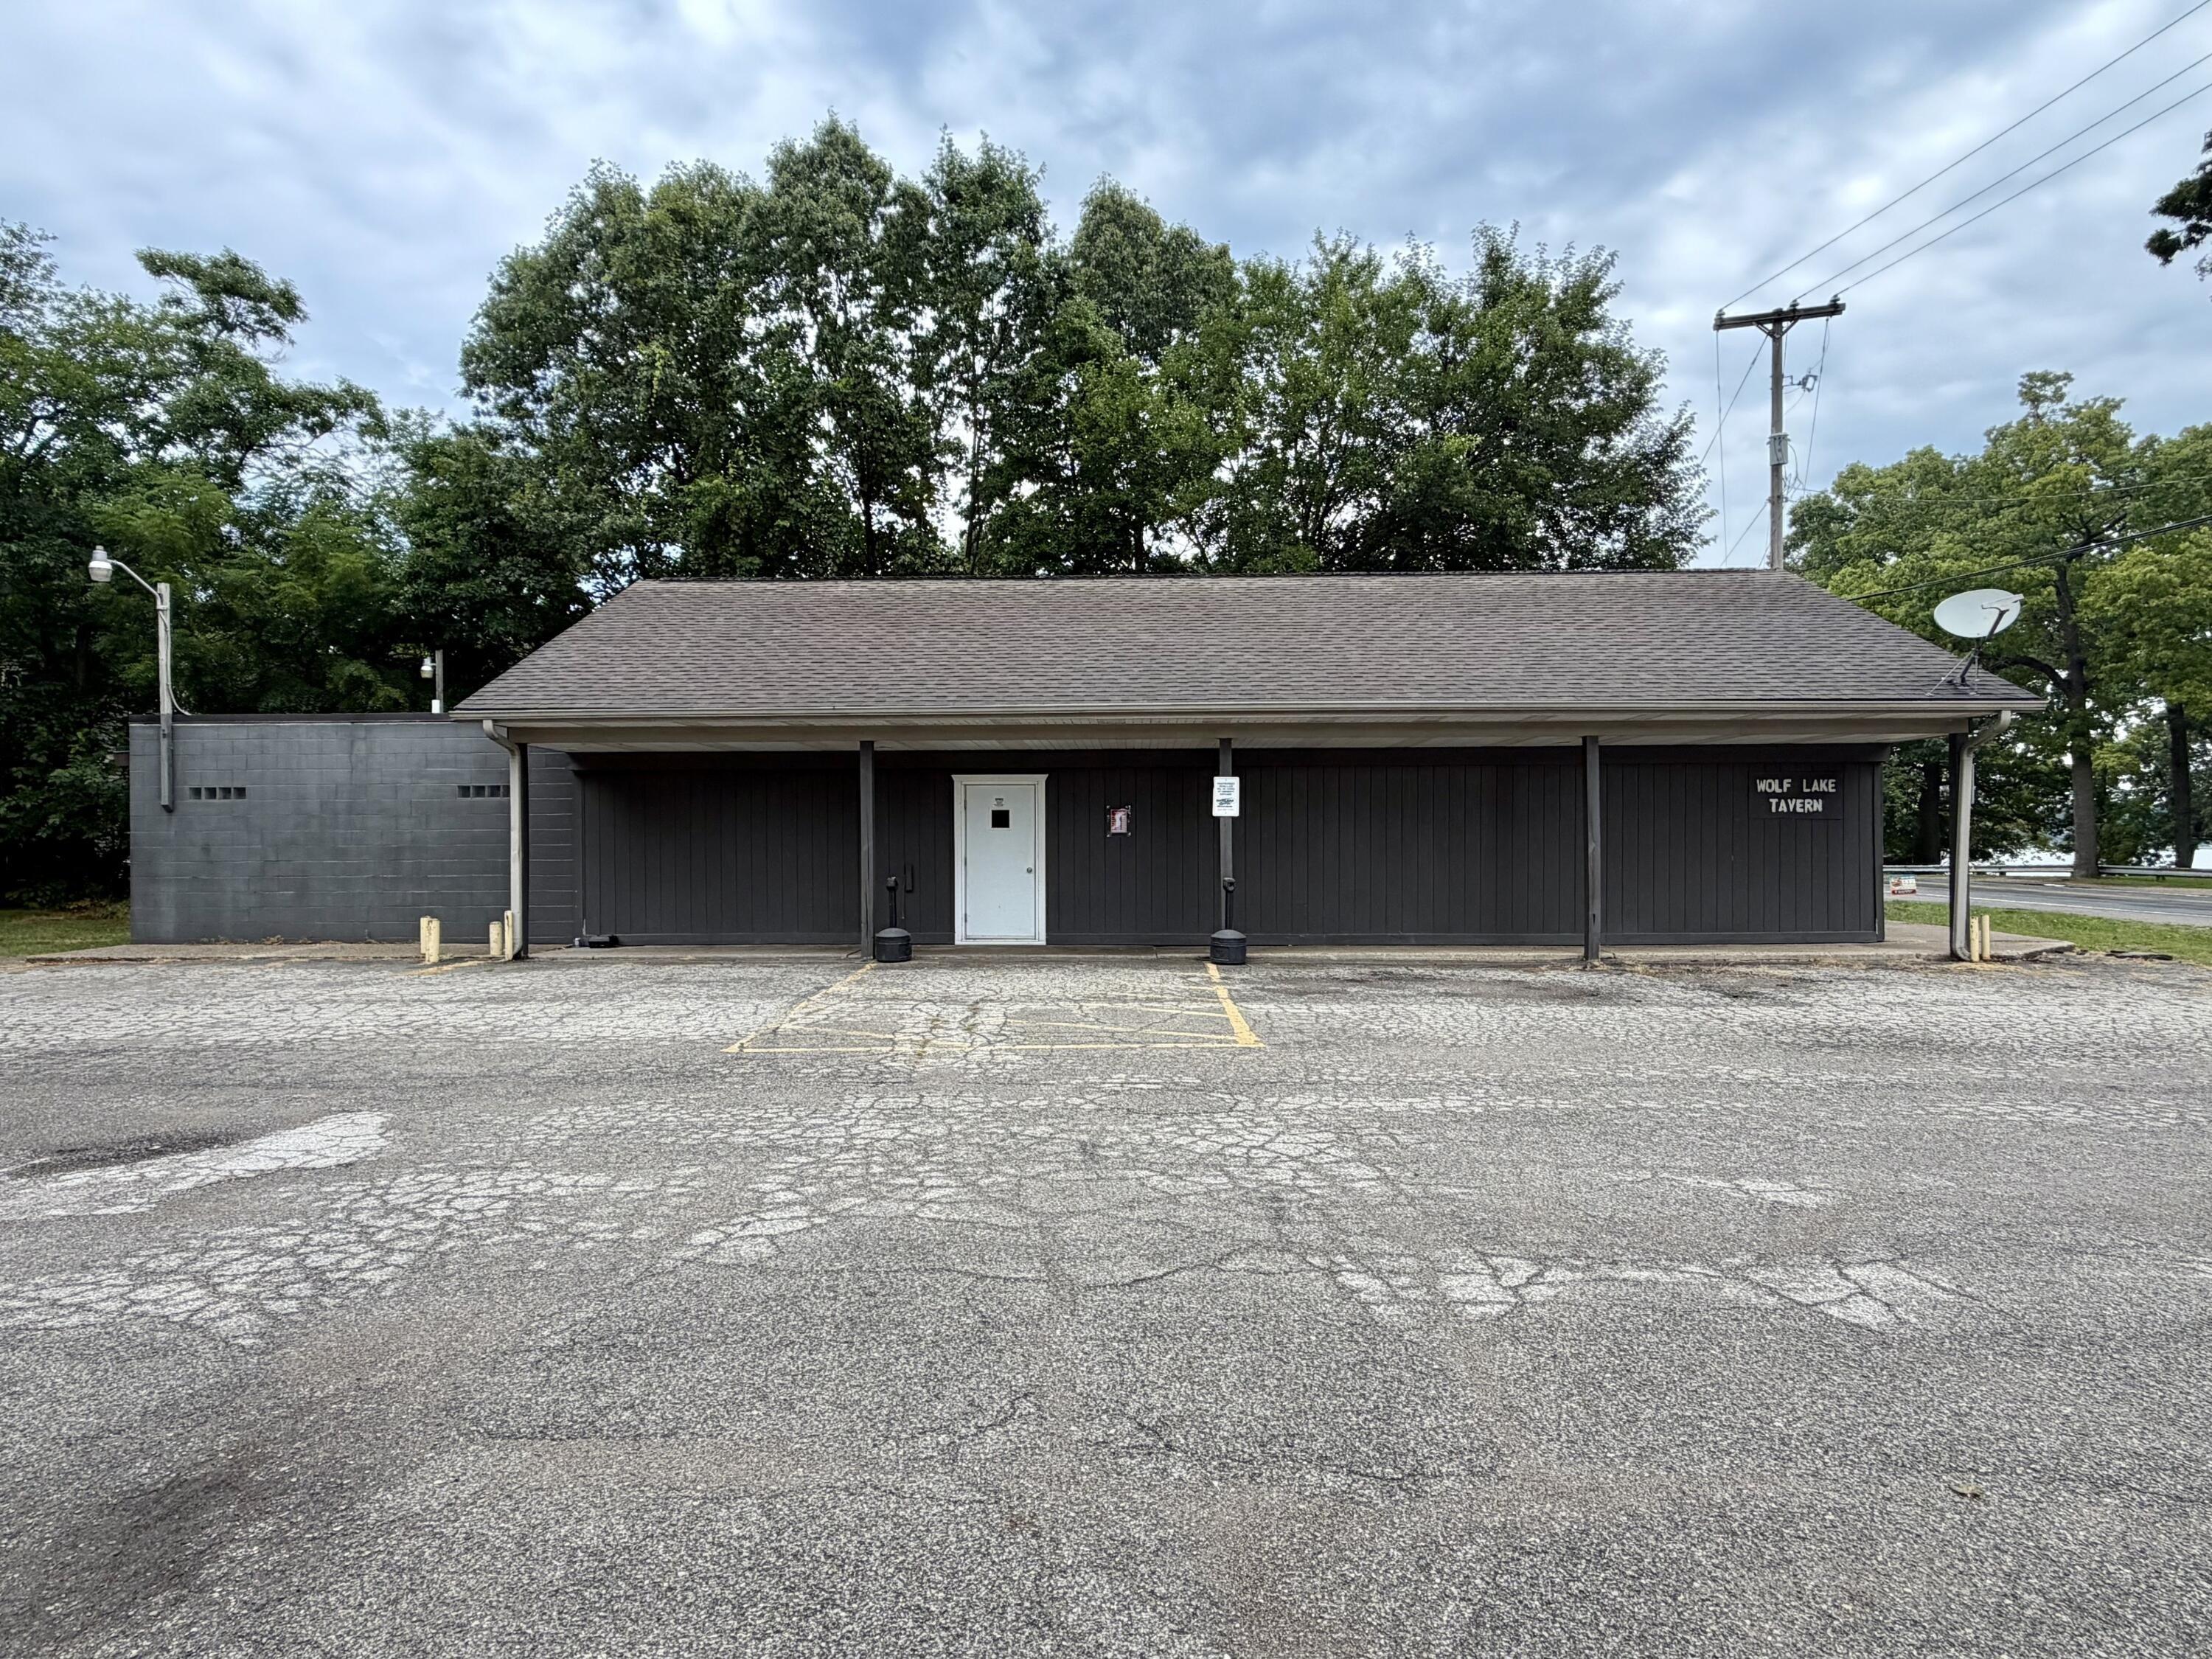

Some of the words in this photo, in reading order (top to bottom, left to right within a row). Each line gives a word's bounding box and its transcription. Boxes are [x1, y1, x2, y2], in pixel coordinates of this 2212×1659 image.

[1756, 779, 1792, 793] WOLF
[1803, 779, 1837, 793] LAKE
[1769, 798, 1823, 813] TAVERN
